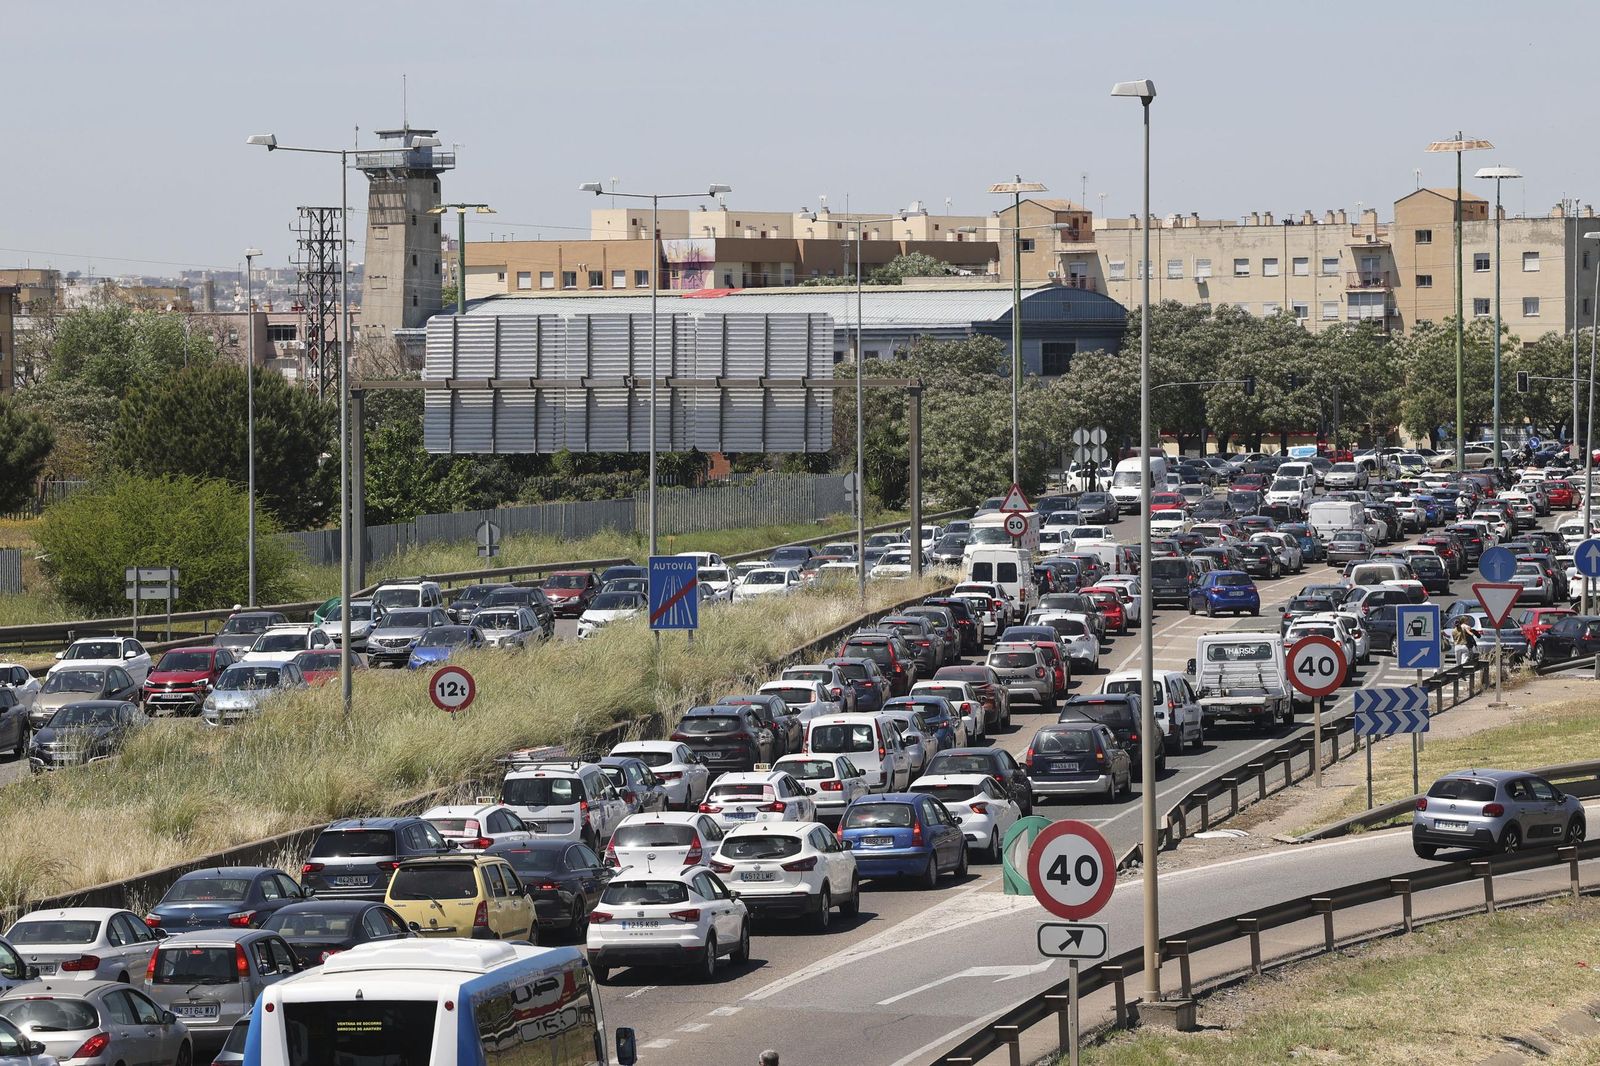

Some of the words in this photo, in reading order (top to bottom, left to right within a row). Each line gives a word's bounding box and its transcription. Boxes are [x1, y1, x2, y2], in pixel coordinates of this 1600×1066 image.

[1009, 521, 1023, 530] 50
[653, 561, 693, 570] AUTOVÍA
[1224, 647, 1256, 655] THARSIS
[1298, 656, 1335, 677] 40
[438, 681, 466, 697] 12t
[1046, 854, 1098, 887] 40
[744, 872, 760, 880] 4512
[761, 872, 774, 880] LMF
[628, 921, 644, 929] 1215
